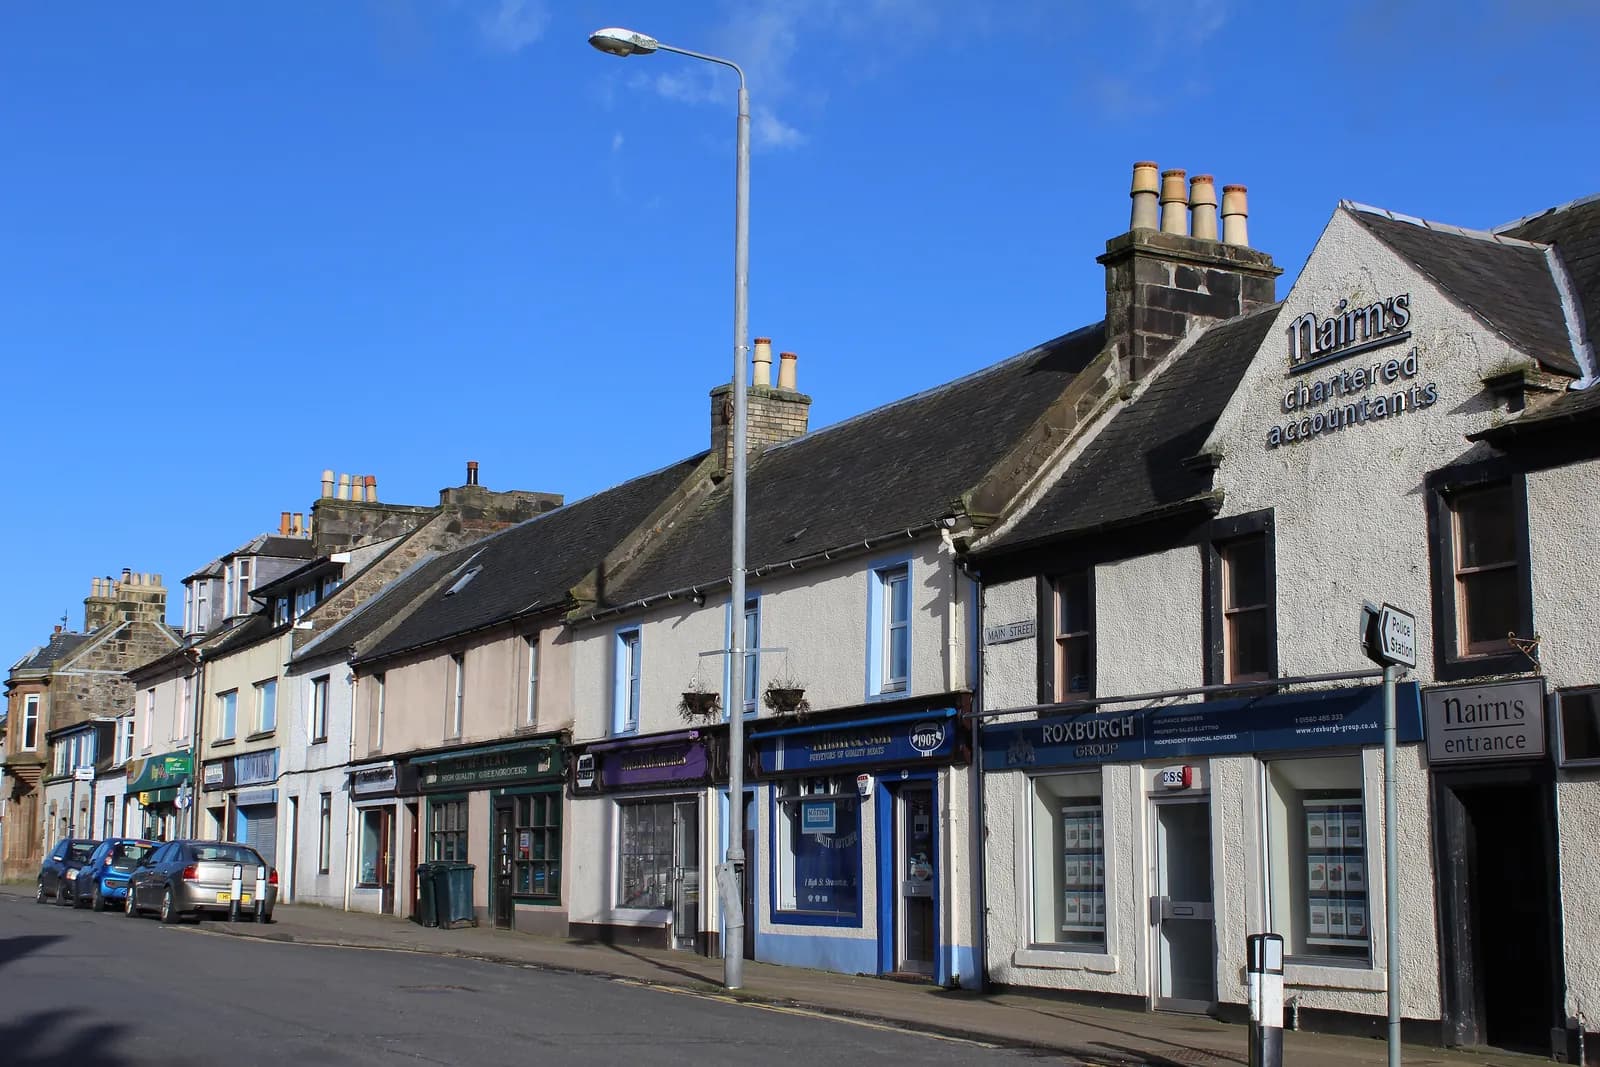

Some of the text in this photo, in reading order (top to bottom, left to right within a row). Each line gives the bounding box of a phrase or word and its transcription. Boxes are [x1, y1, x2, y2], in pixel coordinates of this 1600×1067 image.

[1282, 347, 1418, 410] chartered
[1267, 381, 1438, 447] accountants
[987, 623, 1034, 641] MAIN STREET
[1392, 616, 1410, 637] Police
[1391, 636, 1413, 658] Station
[1042, 715, 1135, 744] ROXBURGH
[1295, 721, 1379, 735] www.roxburgh-group.co.uk
[917, 733, 936, 747] 1903
[1153, 737, 1187, 745] INDEPENDENT
[1444, 734, 1527, 753] entrance
[1074, 743, 1119, 757] GROUP
[441, 766, 527, 782] HIGH QUALITY GREENGROCERS
